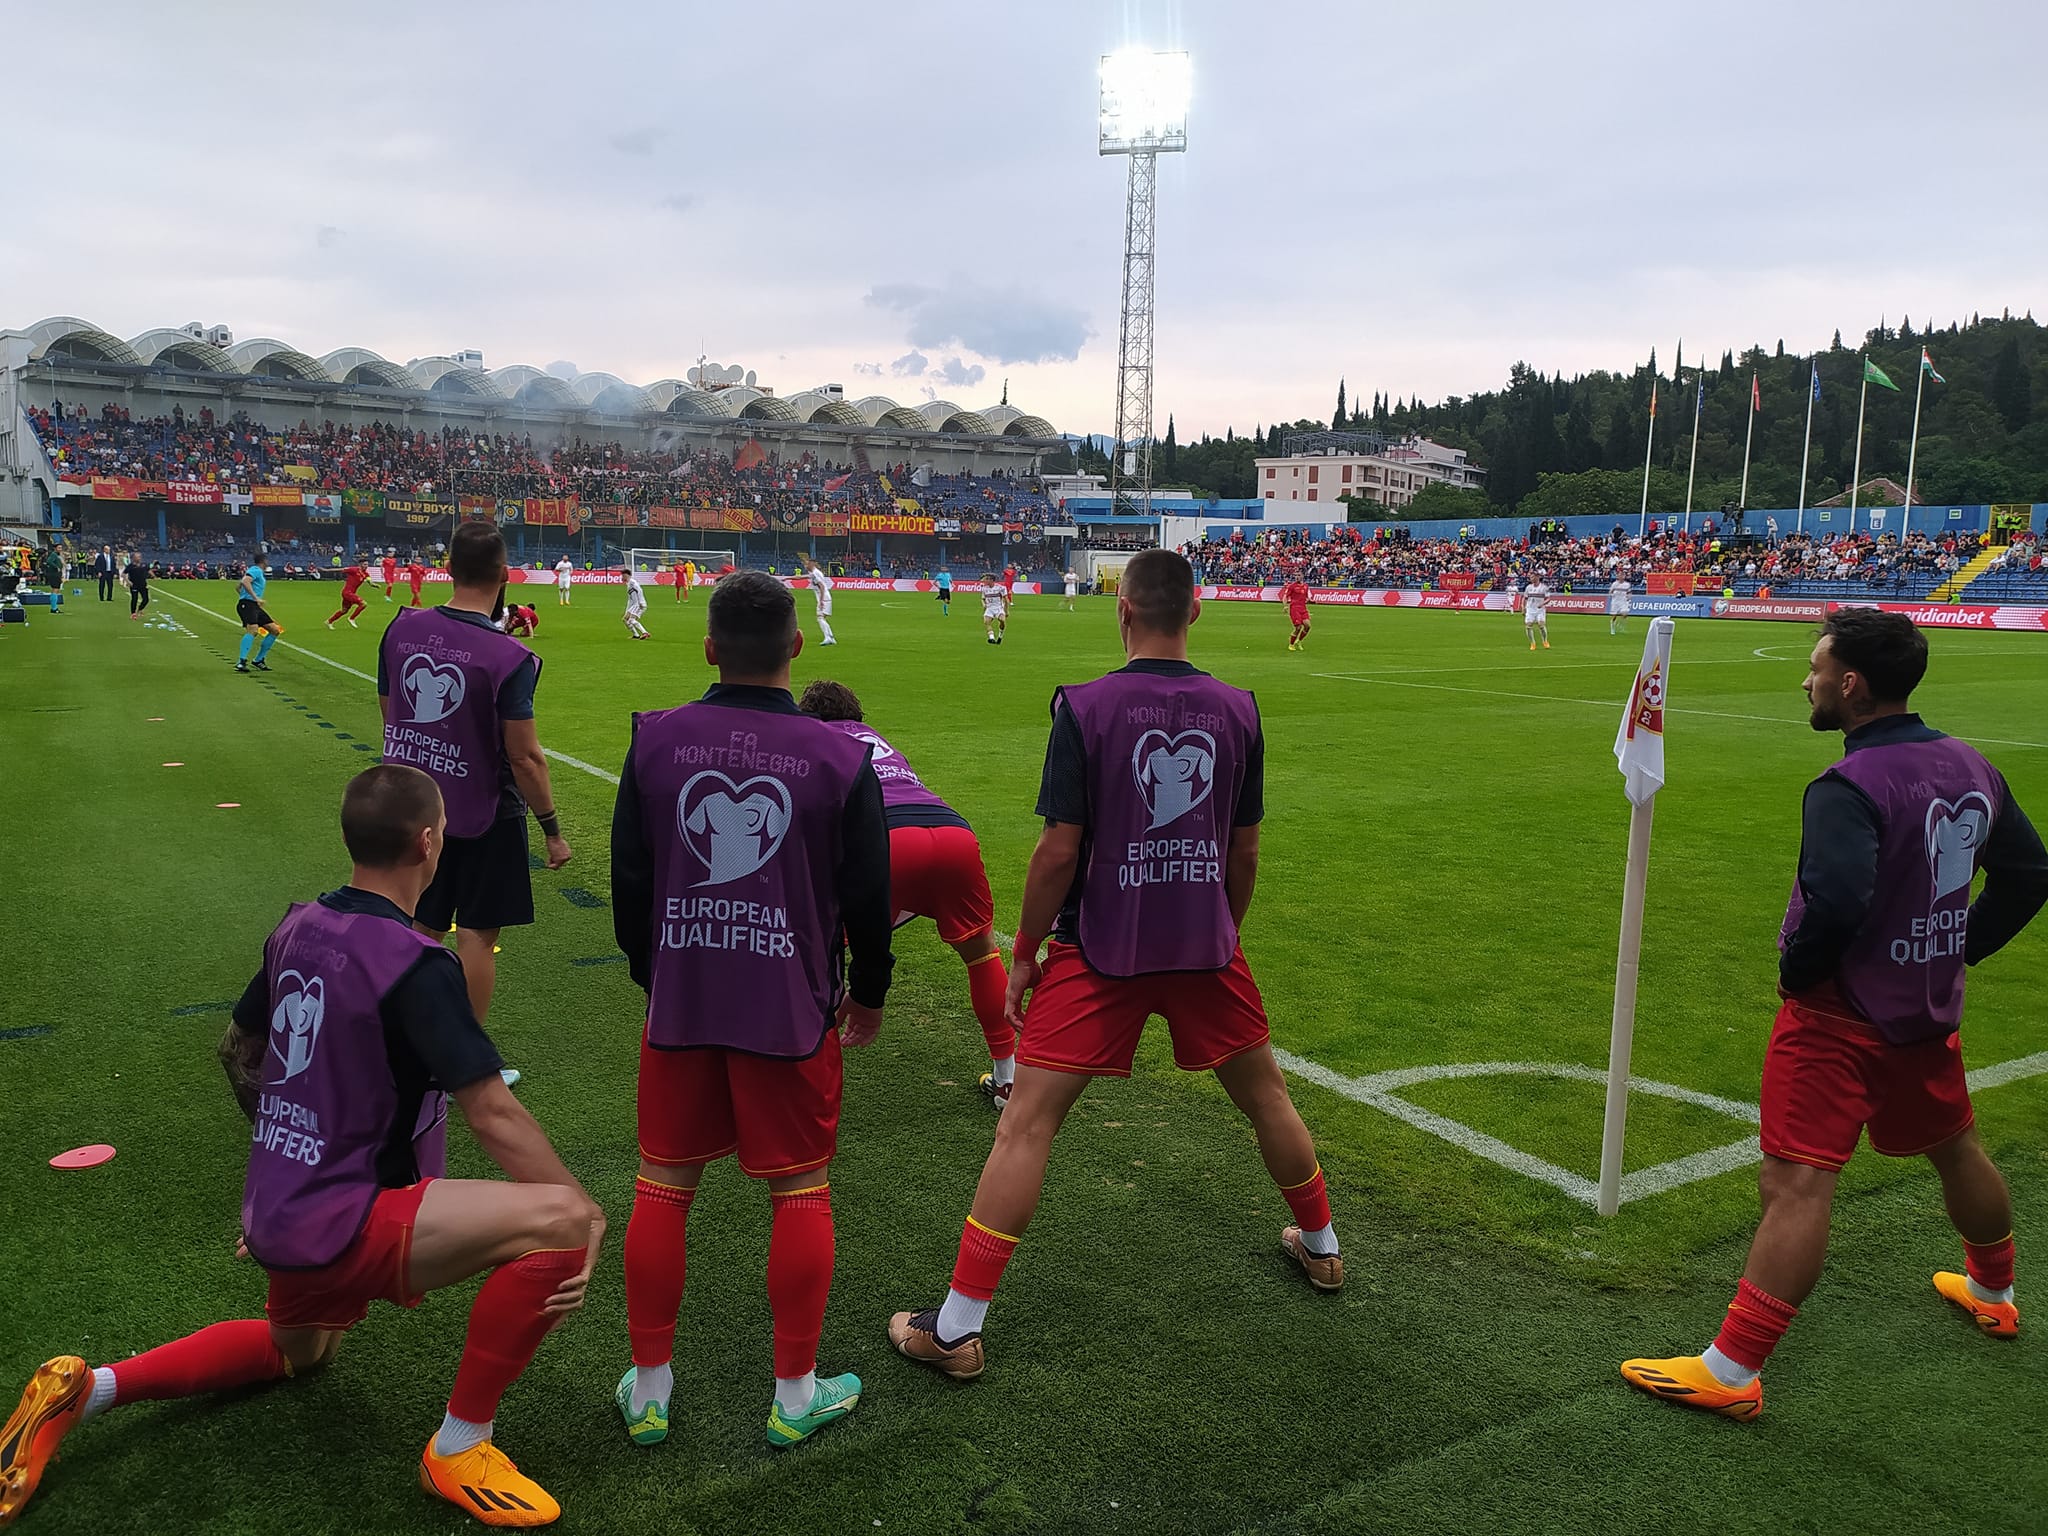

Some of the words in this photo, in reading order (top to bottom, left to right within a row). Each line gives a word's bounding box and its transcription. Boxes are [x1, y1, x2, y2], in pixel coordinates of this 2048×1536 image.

[388, 500, 411, 512] OLD
[423, 502, 455, 515] BOYS
[571, 573, 624, 584] eridianbet
[836, 579, 890, 590] meridianbet
[1313, 591, 1360, 604] meridianbet
[1567, 600, 1606, 609] QUALIFIERS
[1729, 604, 1772, 613] EUROPEAN
[1773, 606, 1821, 615] QUALIFIERS
[428, 634, 444, 646] FA
[396, 641, 472, 664] MONTENEGRO
[384, 724, 462, 759] EUROPEAN
[729, 730, 758, 751] FA
[382, 740, 470, 778] UALIFIERS
[672, 745, 811, 778] MONTENEGRO
[1118, 860, 1222, 891] QUALIFIER
[666, 896, 788, 930] EUROPEAN
[1911, 907, 1968, 938] EUROP
[1890, 931, 1966, 967] QUALIF
